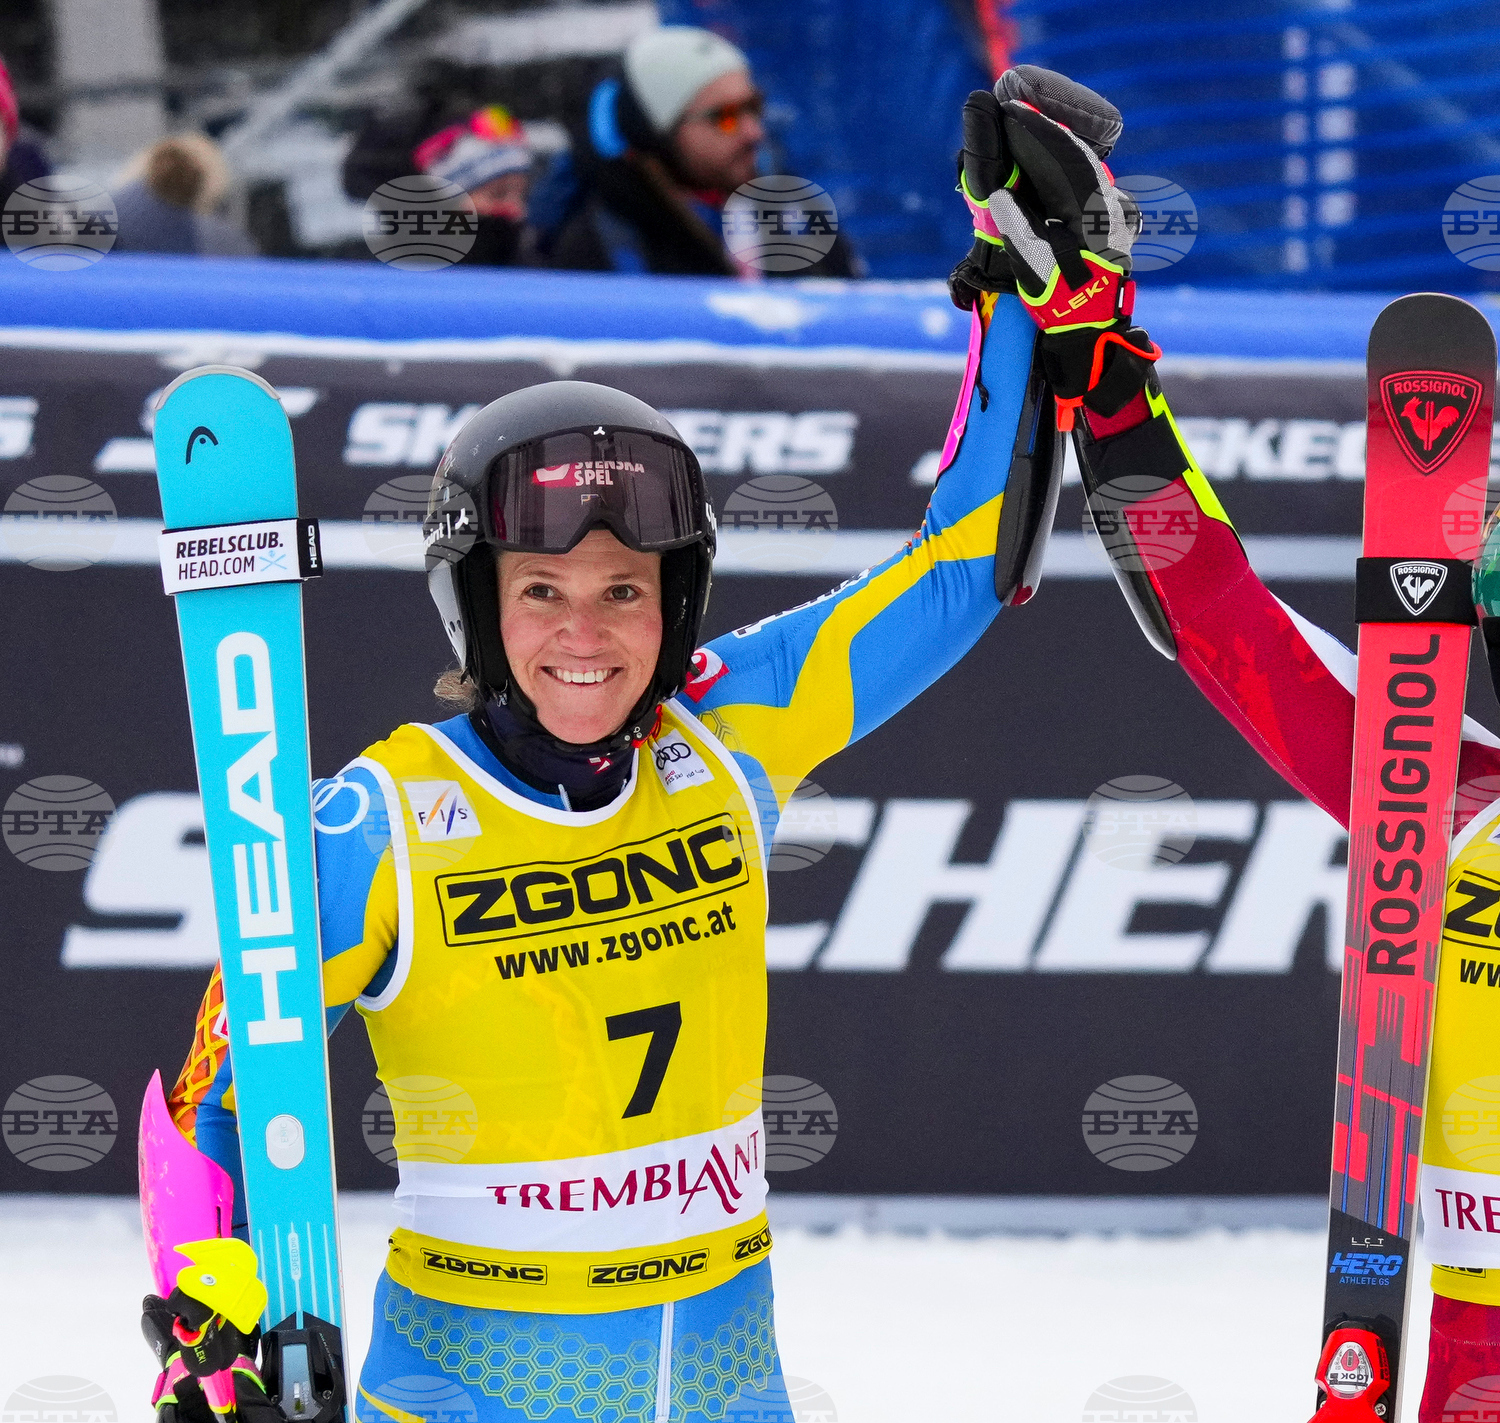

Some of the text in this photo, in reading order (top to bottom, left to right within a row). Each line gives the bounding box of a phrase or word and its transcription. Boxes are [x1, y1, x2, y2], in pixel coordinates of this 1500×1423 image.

[1052, 275, 1110, 318] LEKI
[1393, 379, 1468, 399] ROSSIGNOL
[345, 403, 858, 474] SKERS
[574, 469, 614, 487] SPEL
[176, 531, 284, 559] REBELSCLUB.
[307, 525, 318, 568] HEAD
[178, 556, 255, 580] HEAD.COM
[1397, 565, 1440, 578] ROSSIGNOL
[1366, 633, 1442, 977] ROSSIGNOL
[215, 630, 302, 1047] HEAD
[446, 824, 743, 936] ZGONC
[495, 900, 737, 980] www.zgonc.at
[606, 1001, 682, 1120] 7
[487, 1130, 760, 1215] TREMBLANT
[425, 1253, 545, 1282] ZGONC
[591, 1251, 708, 1285] ZGONC
[1329, 1252, 1404, 1277] HERO
[1339, 1277, 1390, 1286] ATHLETE GS
